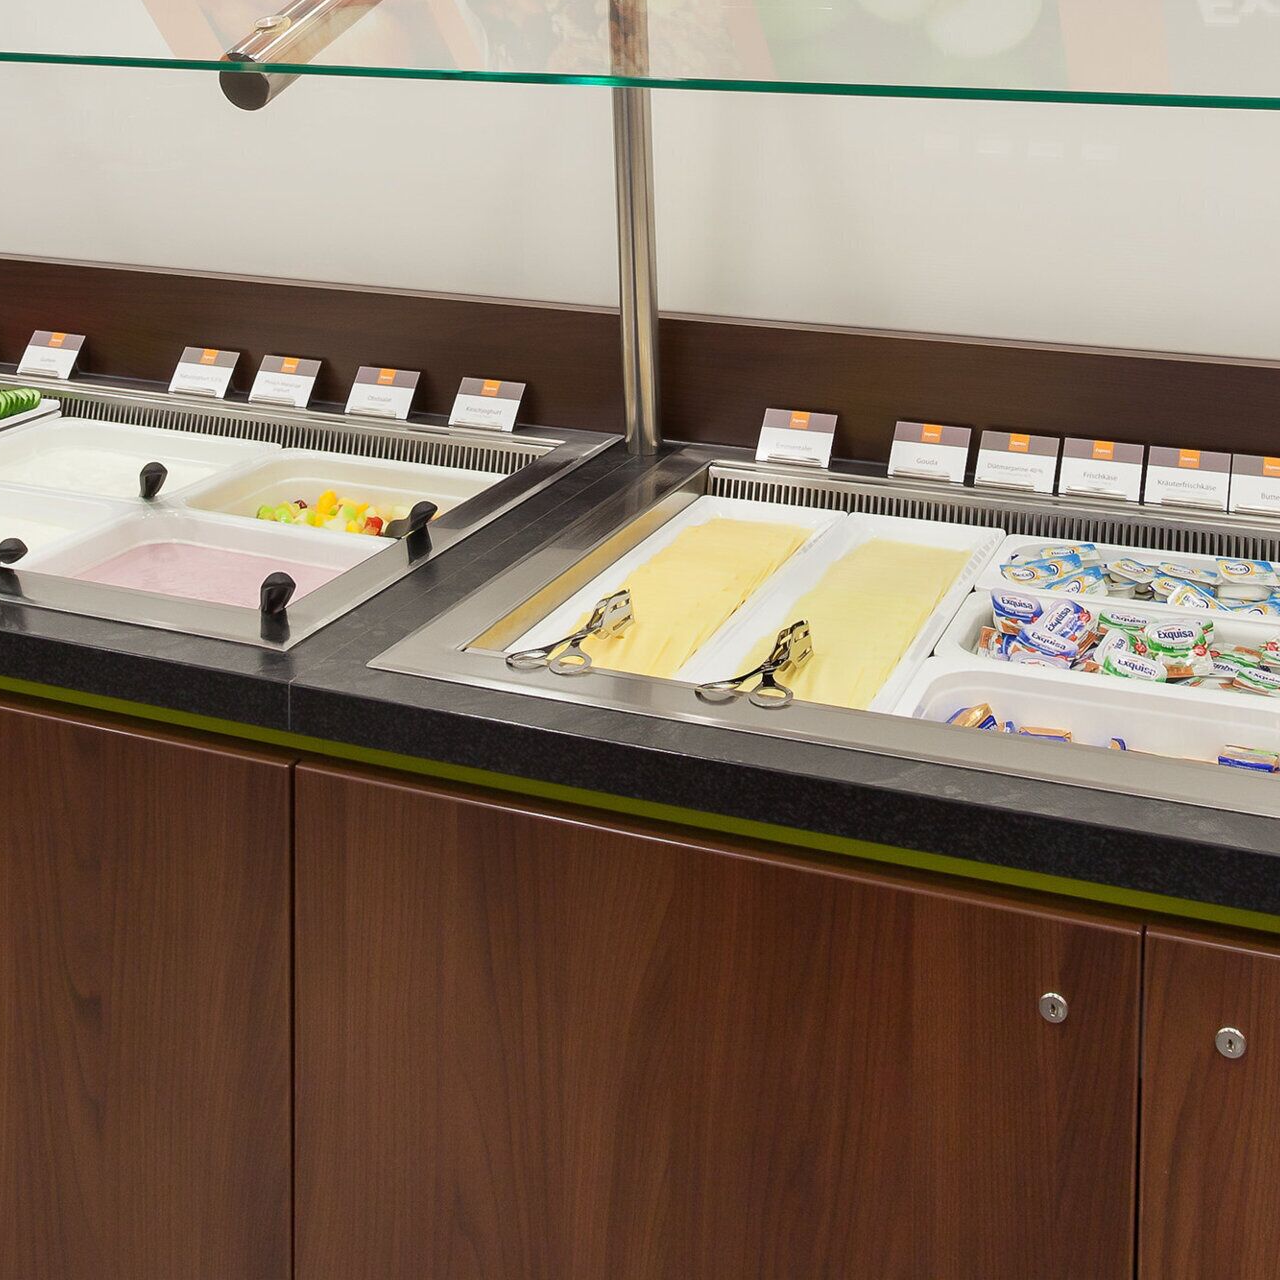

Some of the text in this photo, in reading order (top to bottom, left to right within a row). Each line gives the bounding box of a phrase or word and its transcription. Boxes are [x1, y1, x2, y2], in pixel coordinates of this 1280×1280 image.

[916, 457, 939, 466] Gouda
[1083, 471, 1119, 481] Frischkäse
[1157, 479, 1217, 491] Kräuterfrischkäse
[1001, 596, 1034, 610] Exquisa
[1157, 628, 1195, 640] Exquisa
